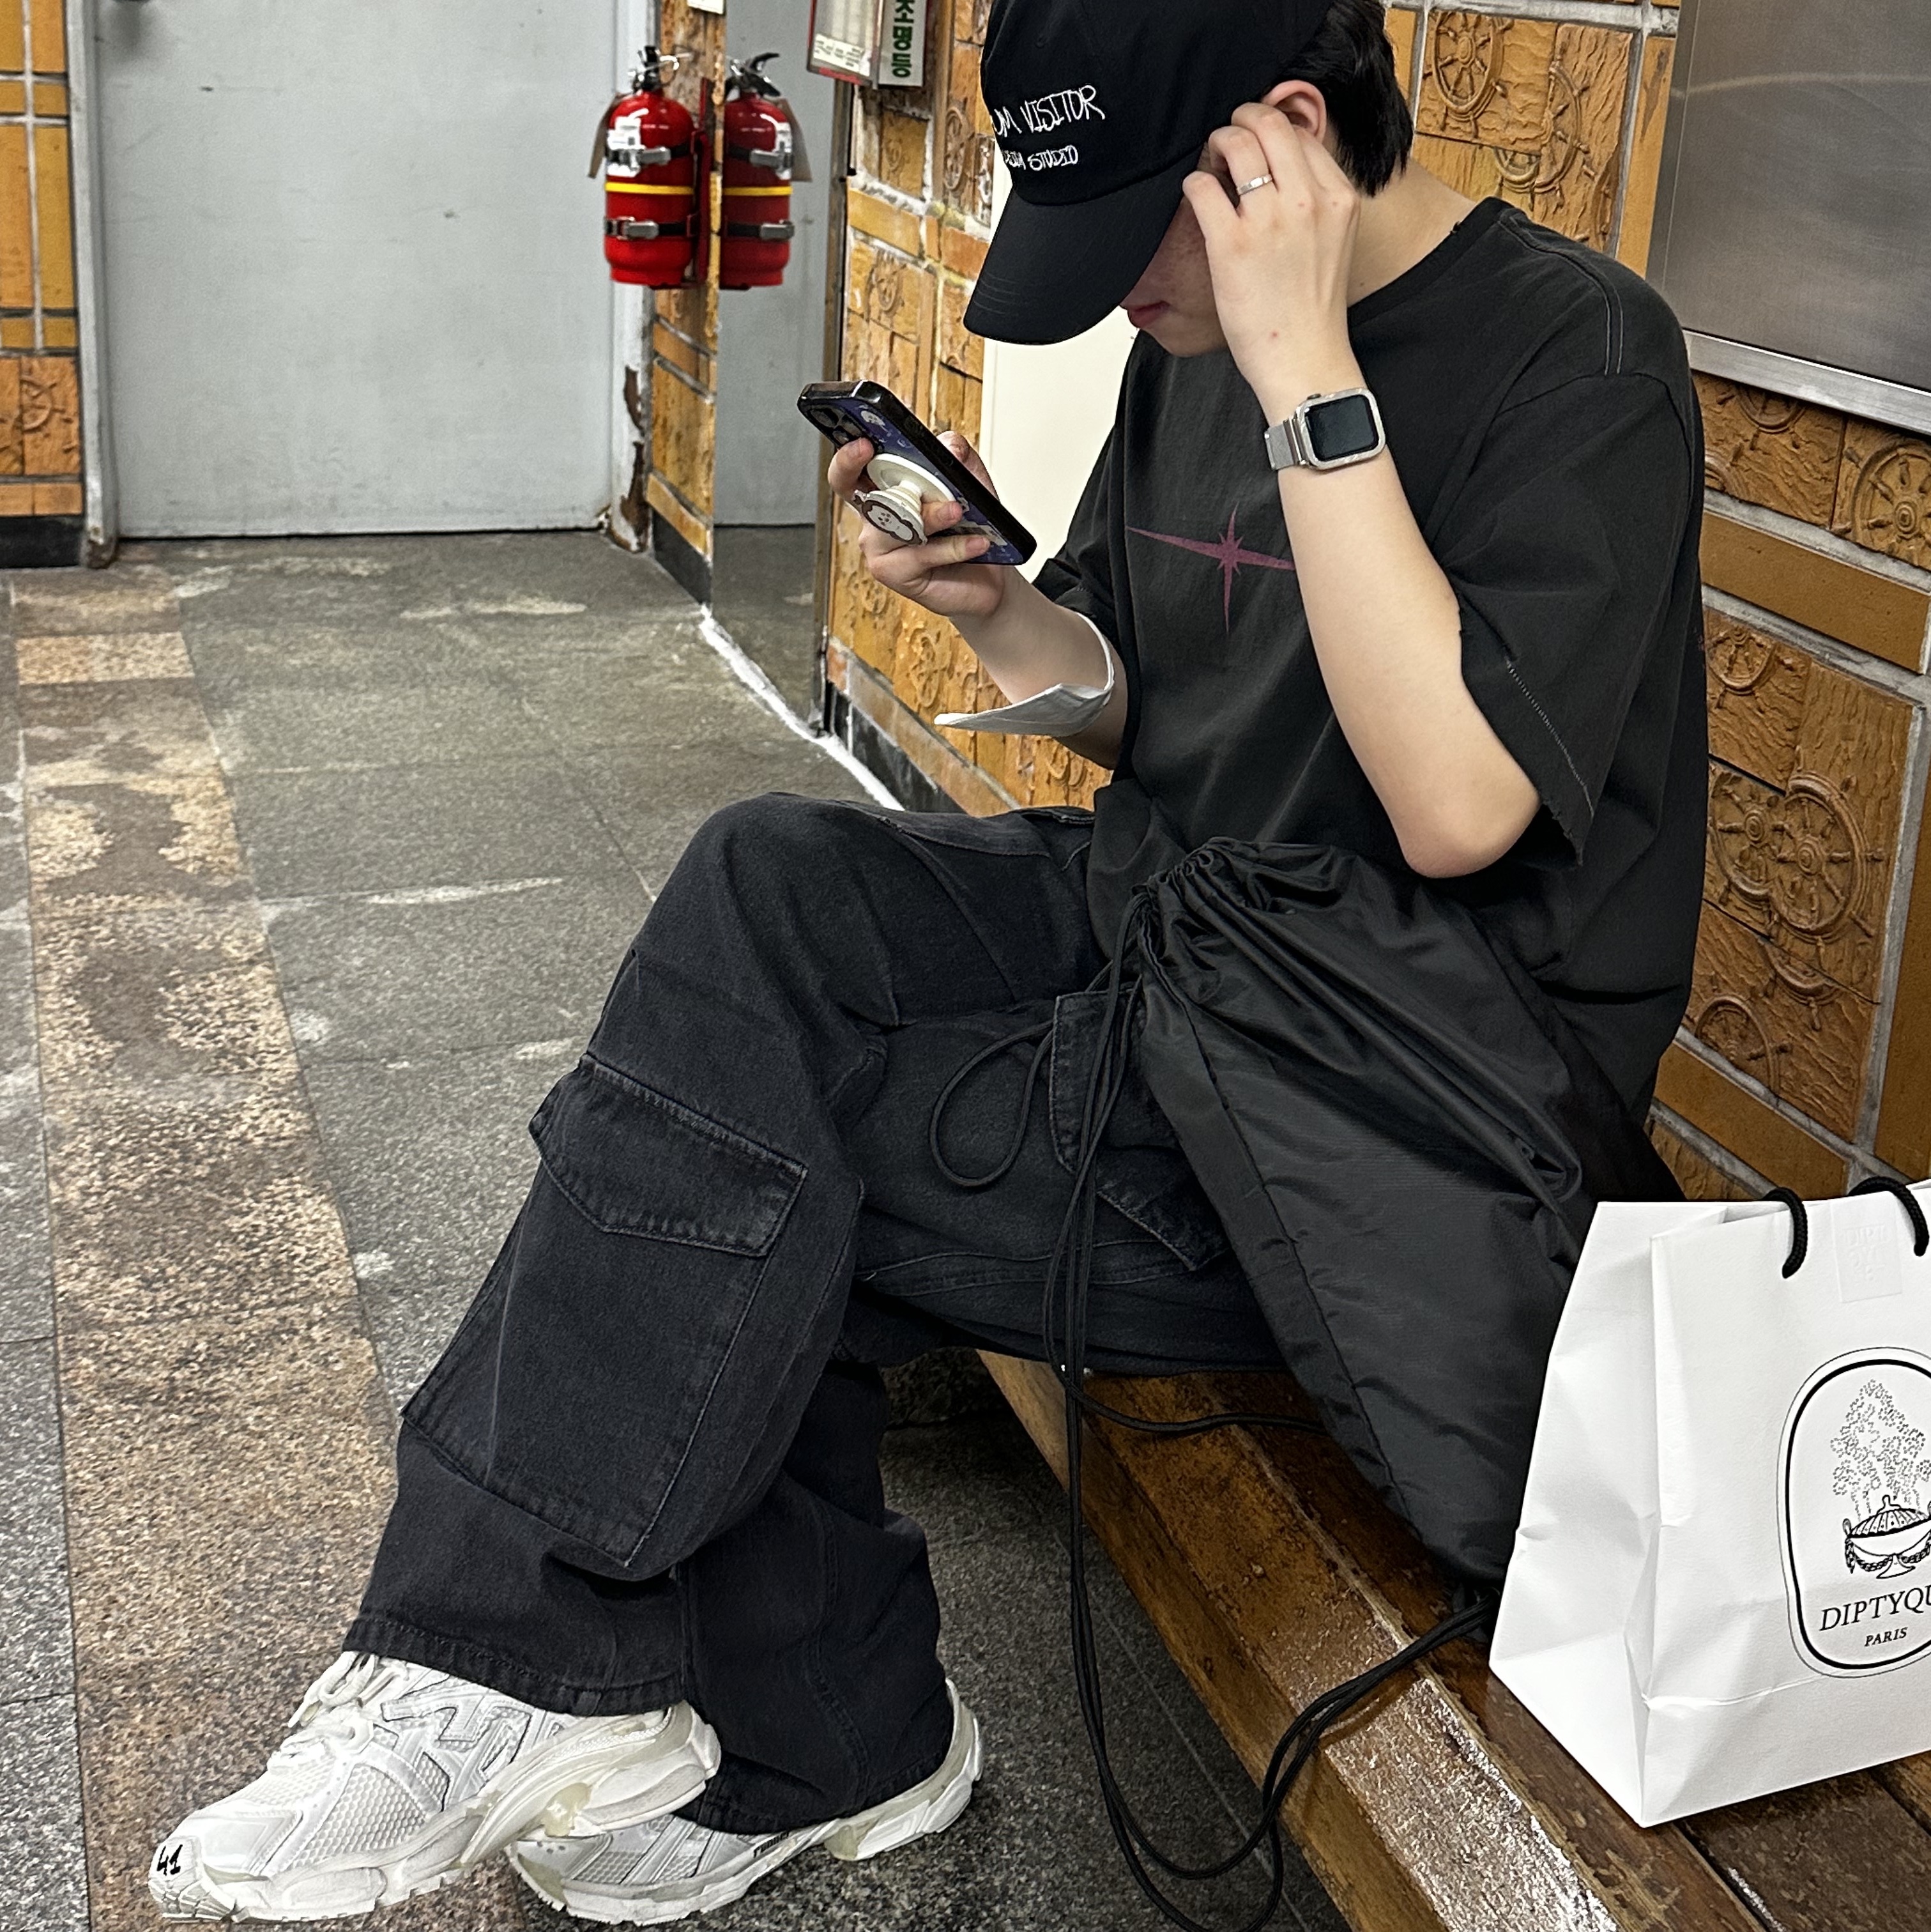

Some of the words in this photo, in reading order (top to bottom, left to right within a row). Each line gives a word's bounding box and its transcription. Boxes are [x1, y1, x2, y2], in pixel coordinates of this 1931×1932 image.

[1019, 84, 1106, 134] VISITOR
[1027, 144, 1079, 171] STUDIO
[1864, 1627, 1908, 1647] PARIS
[156, 1844, 183, 1876] 41
